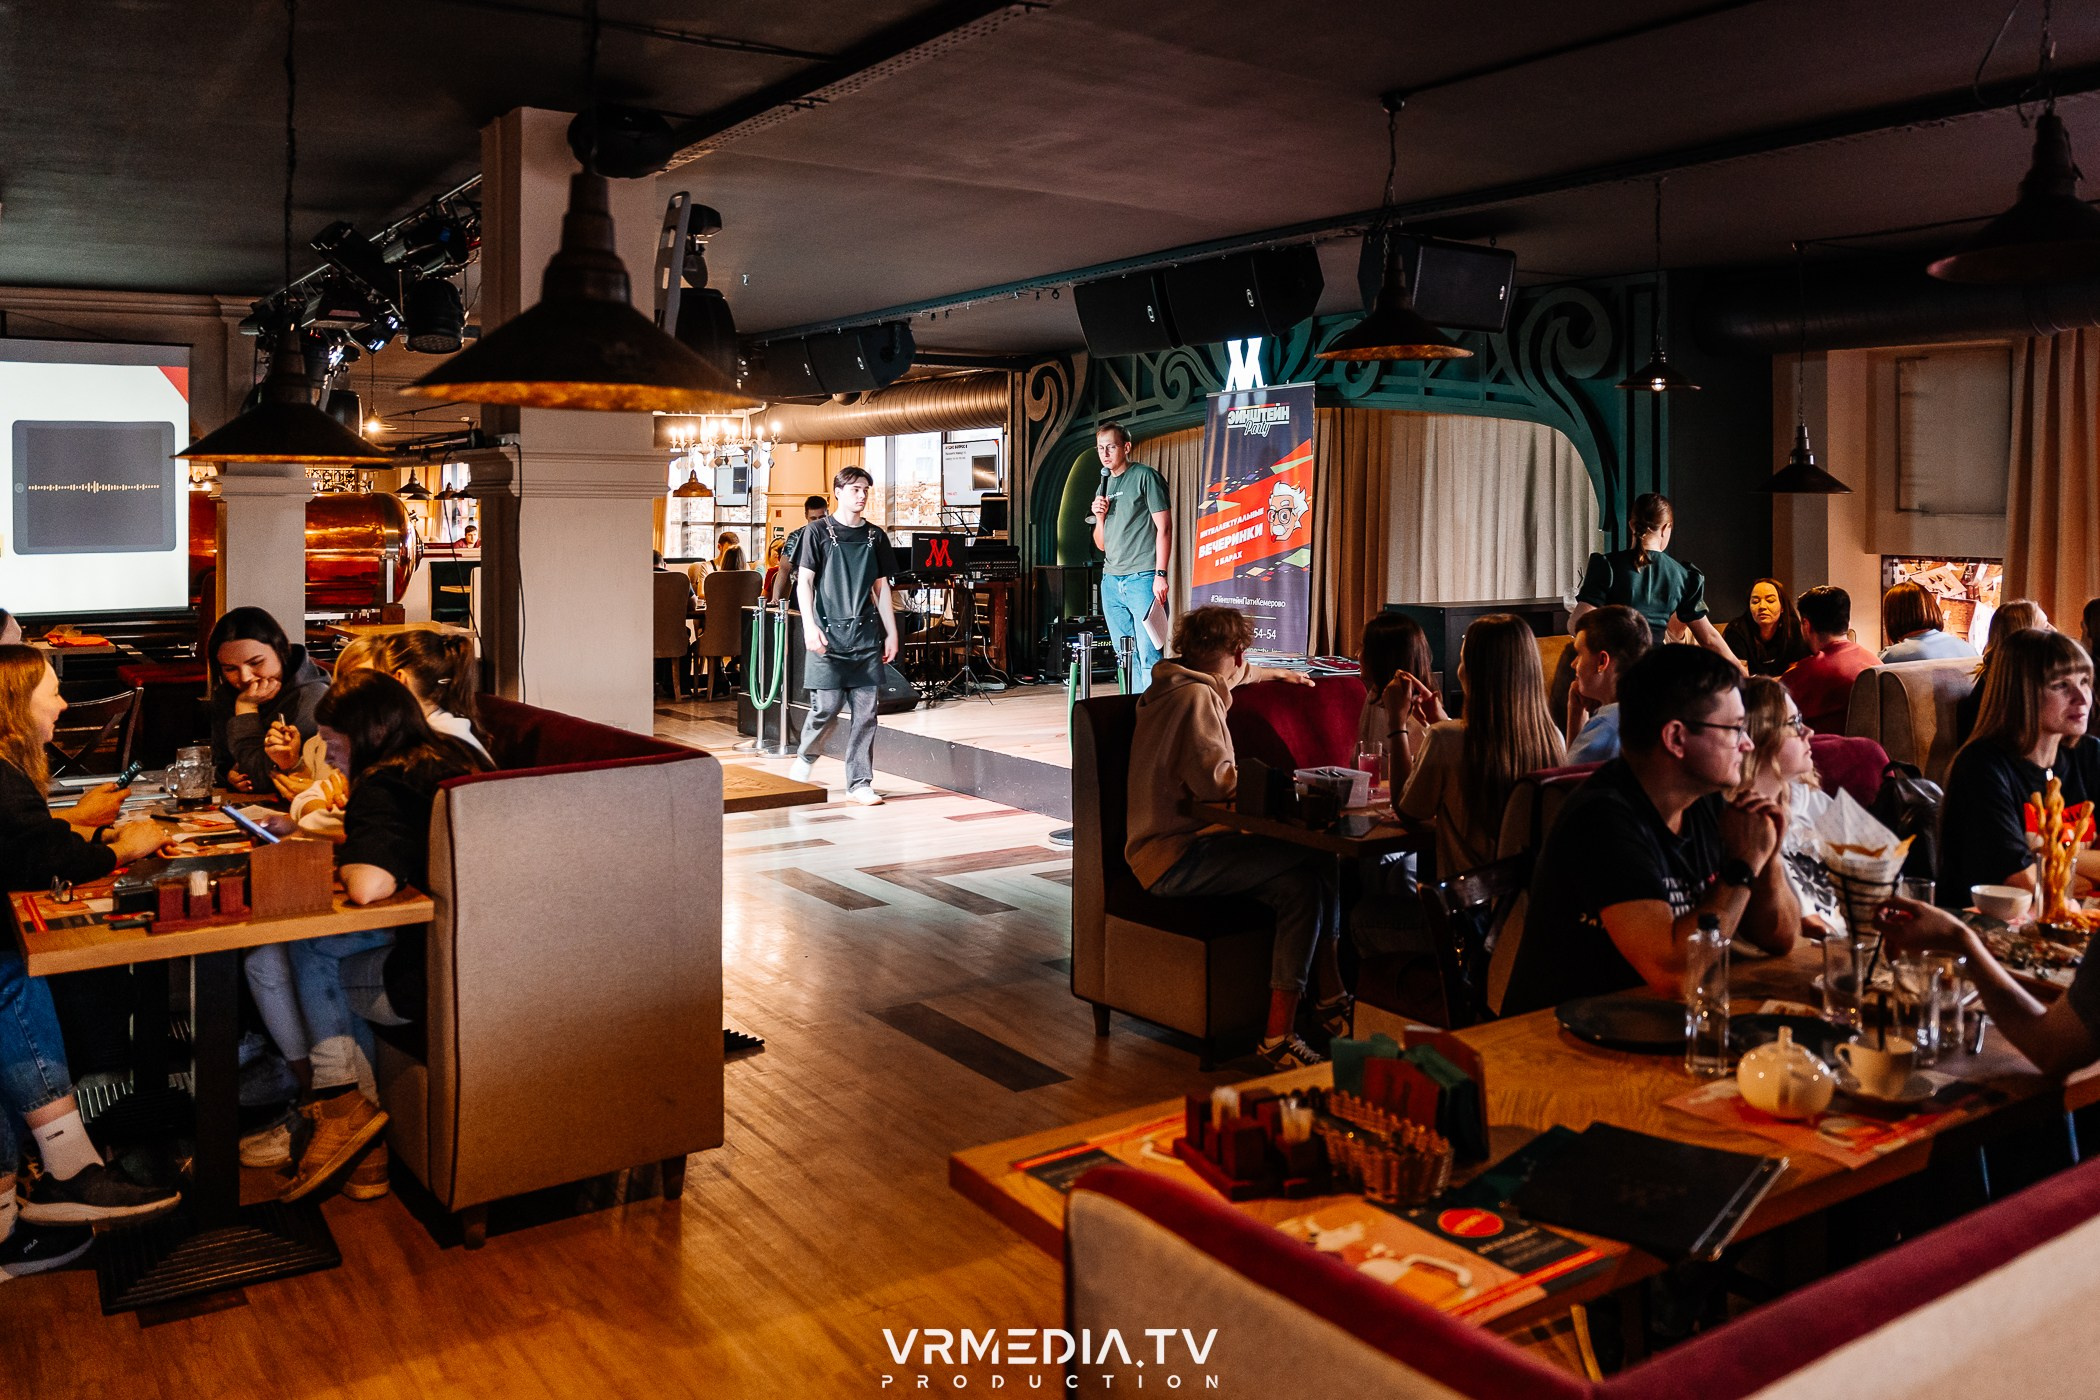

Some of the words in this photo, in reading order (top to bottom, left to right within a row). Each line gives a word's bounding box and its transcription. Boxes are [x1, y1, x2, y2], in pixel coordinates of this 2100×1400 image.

[1244, 420, 1271, 437] Party
[1200, 507, 1264, 539] ИНТЕЛЛЕКТУАЛЬНЫЕ
[1198, 523, 1263, 559] ВЕЧЕРИНКИ
[1220, 551, 1243, 565] БАРАХ
[1210, 595, 1286, 608] #ЭйнштейнПатиКемерово
